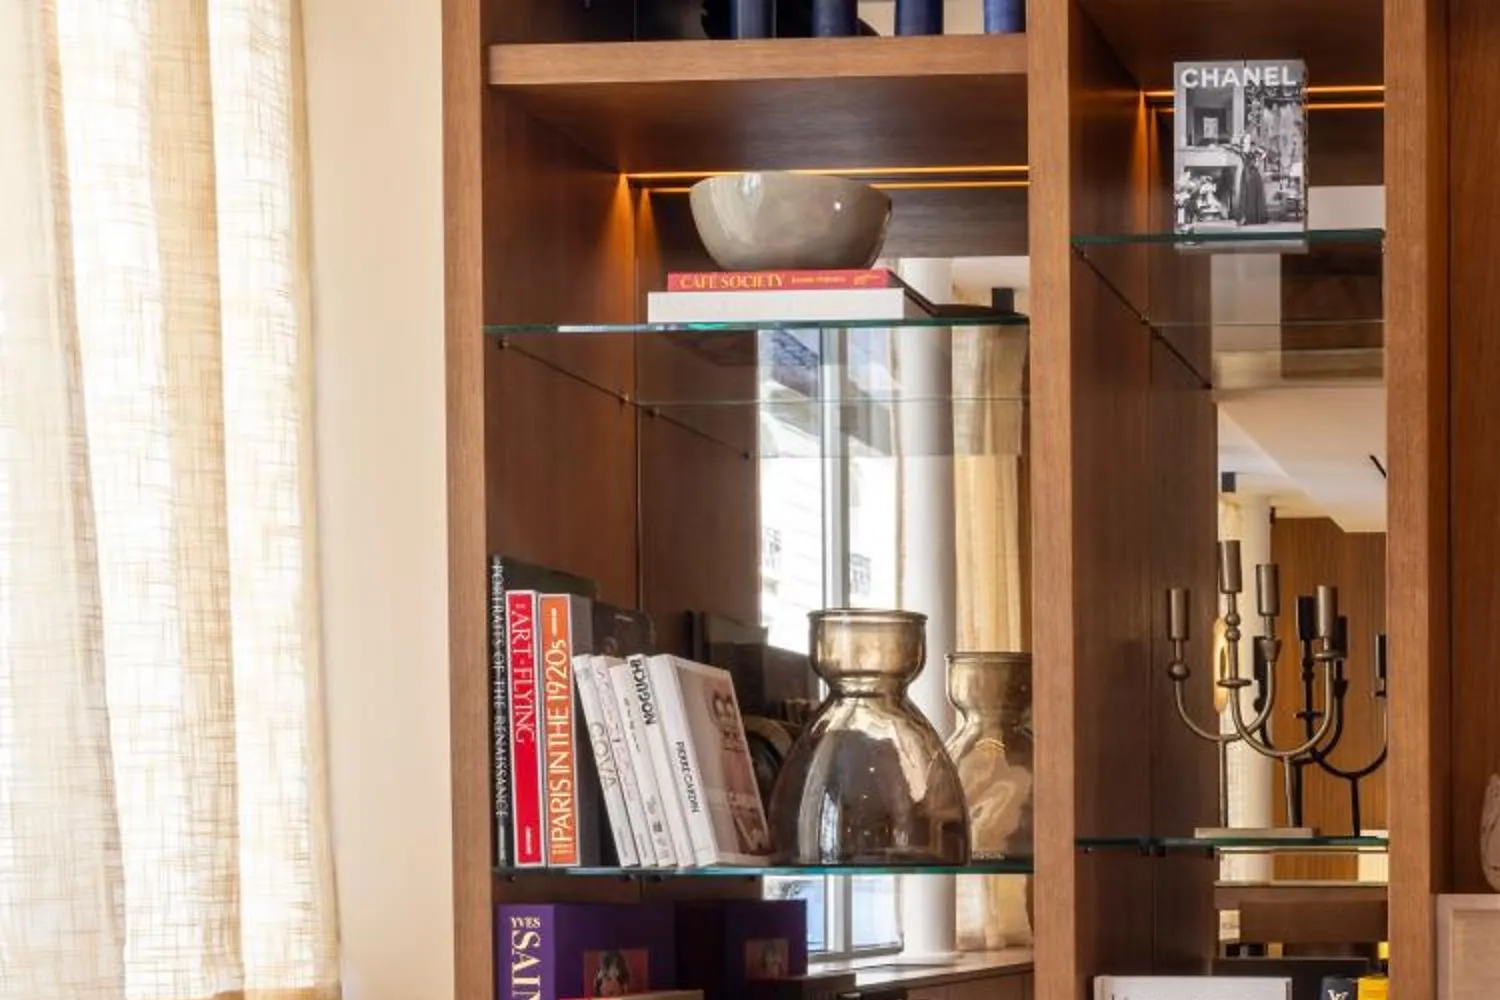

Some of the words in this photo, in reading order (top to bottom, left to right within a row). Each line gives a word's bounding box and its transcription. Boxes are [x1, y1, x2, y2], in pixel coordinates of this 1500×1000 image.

[1180, 65, 1297, 89] CHANEL
[493, 653, 506, 672] OF
[545, 638, 568, 702] 1920s
[493, 680, 507, 709] THE
[513, 667, 535, 744] FLYING
[547, 706, 570, 750] THE
[494, 712, 508, 818] RENAISSANCE
[548, 751, 570, 774] IN
[549, 777, 573, 842] PARIS
[511, 915, 541, 929] YVES
